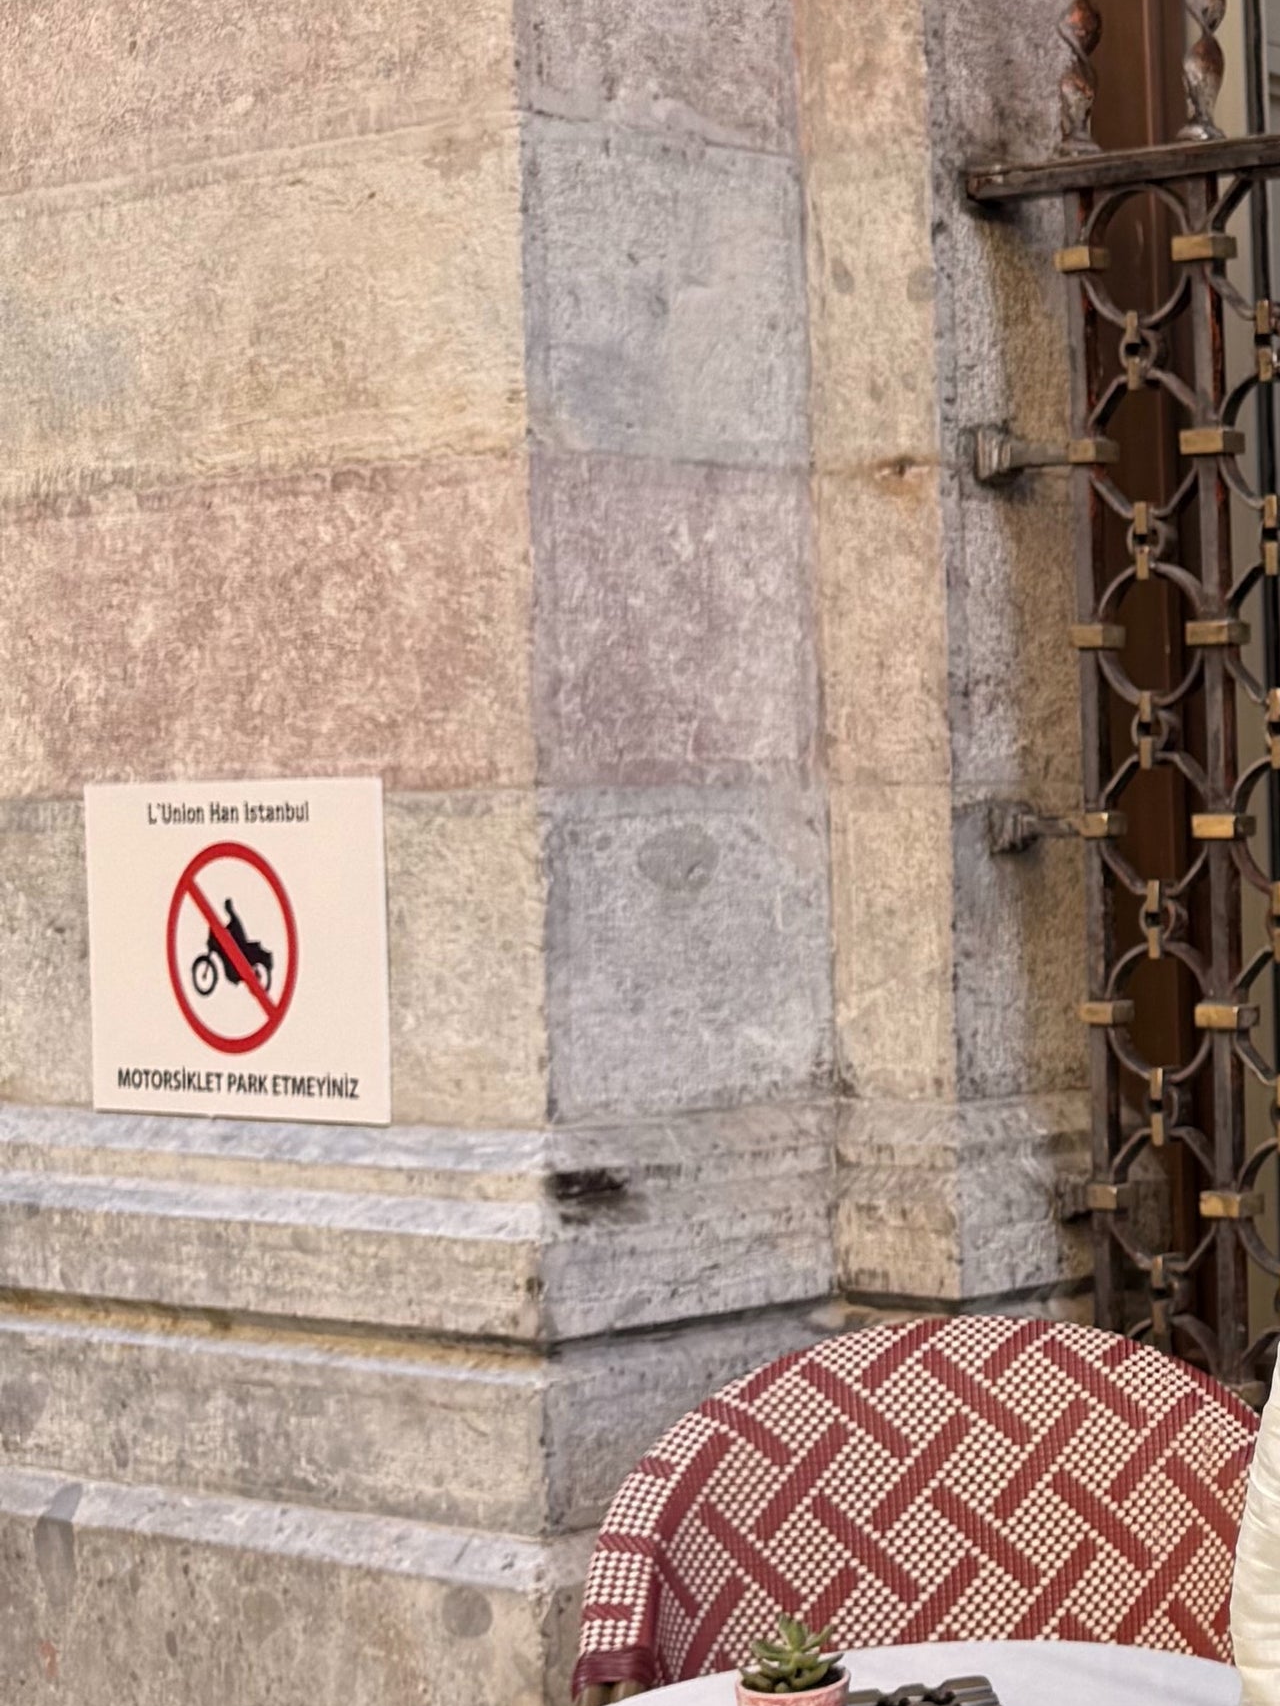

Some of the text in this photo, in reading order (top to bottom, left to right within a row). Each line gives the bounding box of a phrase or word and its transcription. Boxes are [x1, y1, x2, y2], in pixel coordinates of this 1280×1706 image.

[208, 801, 239, 824] Han
[117, 1065, 359, 1100] MOTORSİKLET PARK ETMEYİNİZ
